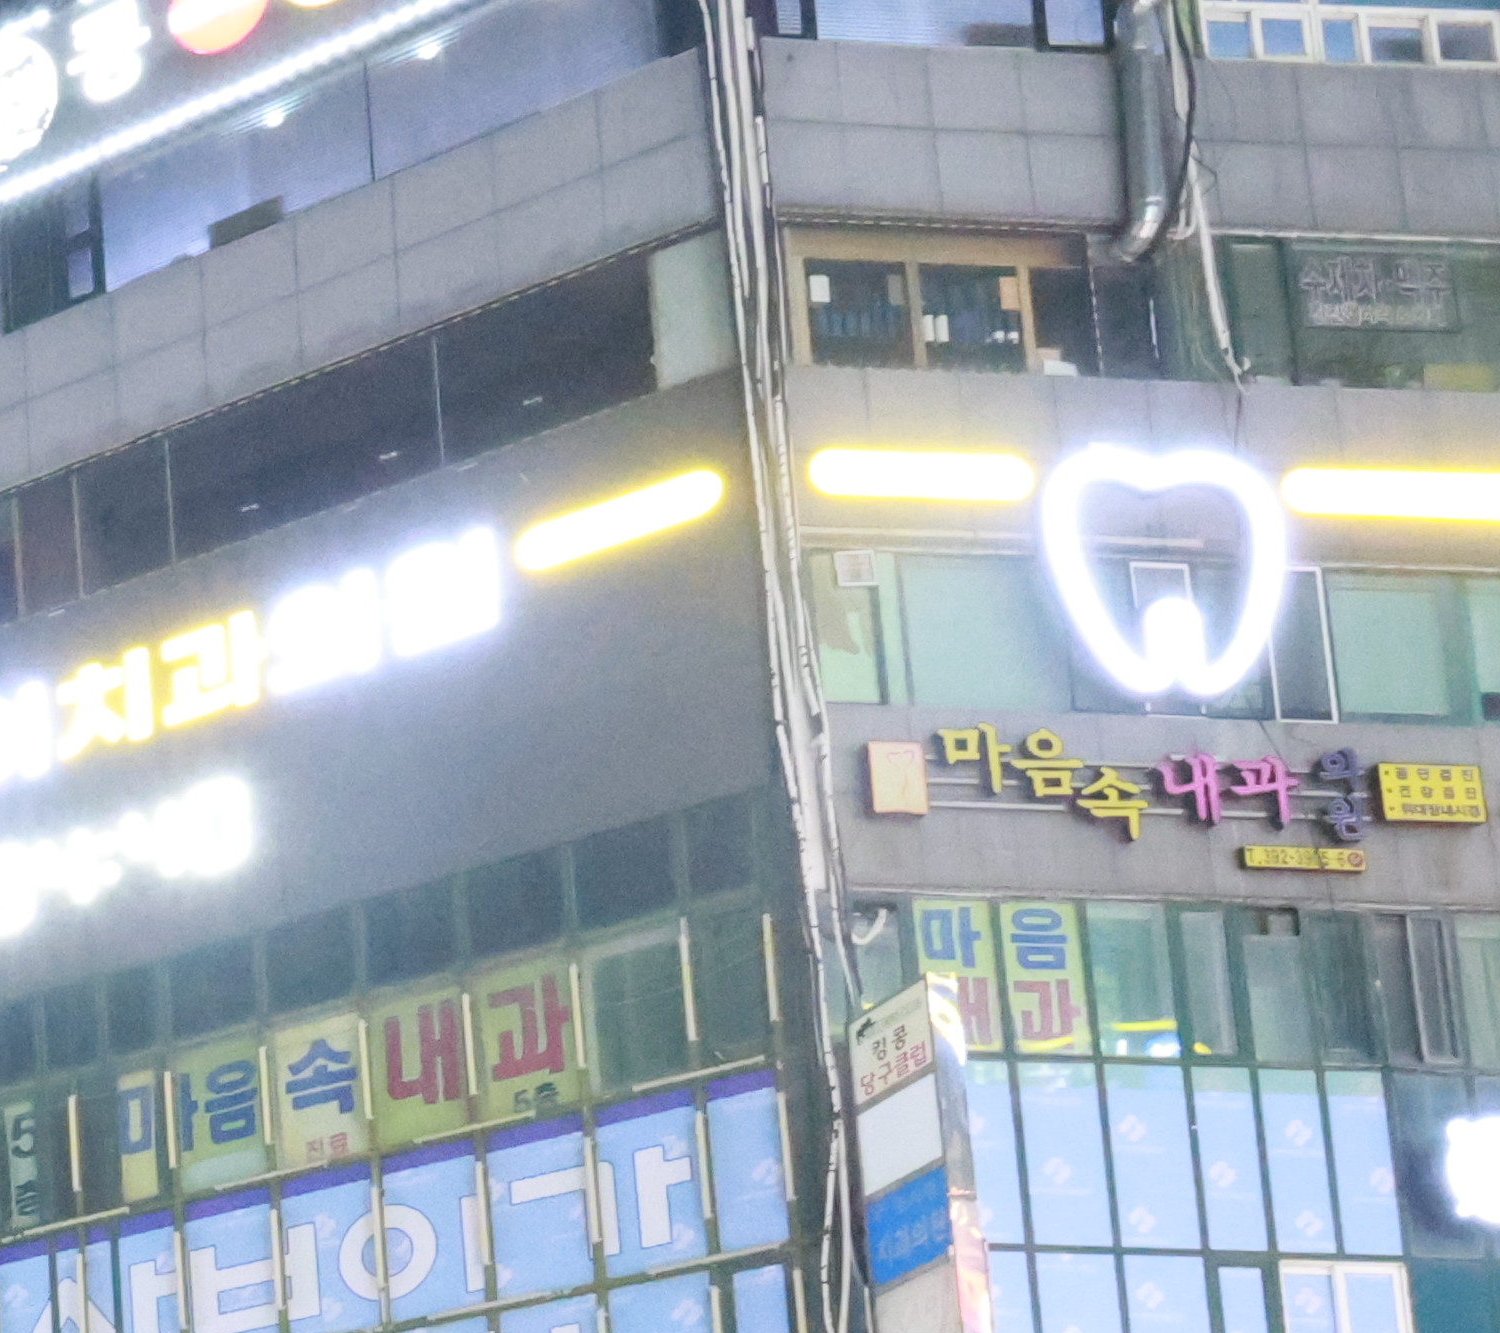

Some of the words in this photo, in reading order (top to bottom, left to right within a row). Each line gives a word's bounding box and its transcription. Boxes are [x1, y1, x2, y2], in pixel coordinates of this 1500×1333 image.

[938, 722, 1148, 841] 마음속
[1155, 748, 1300, 830] 내과
[1317, 747, 1368, 842] 의원
[920, 904, 1068, 970] 마음
[116, 1039, 358, 1158] 마음속
[385, 975, 569, 1108] 내과
[859, 1040, 928, 1096] 당구클럽
[872, 1023, 909, 1061] 킹콩
